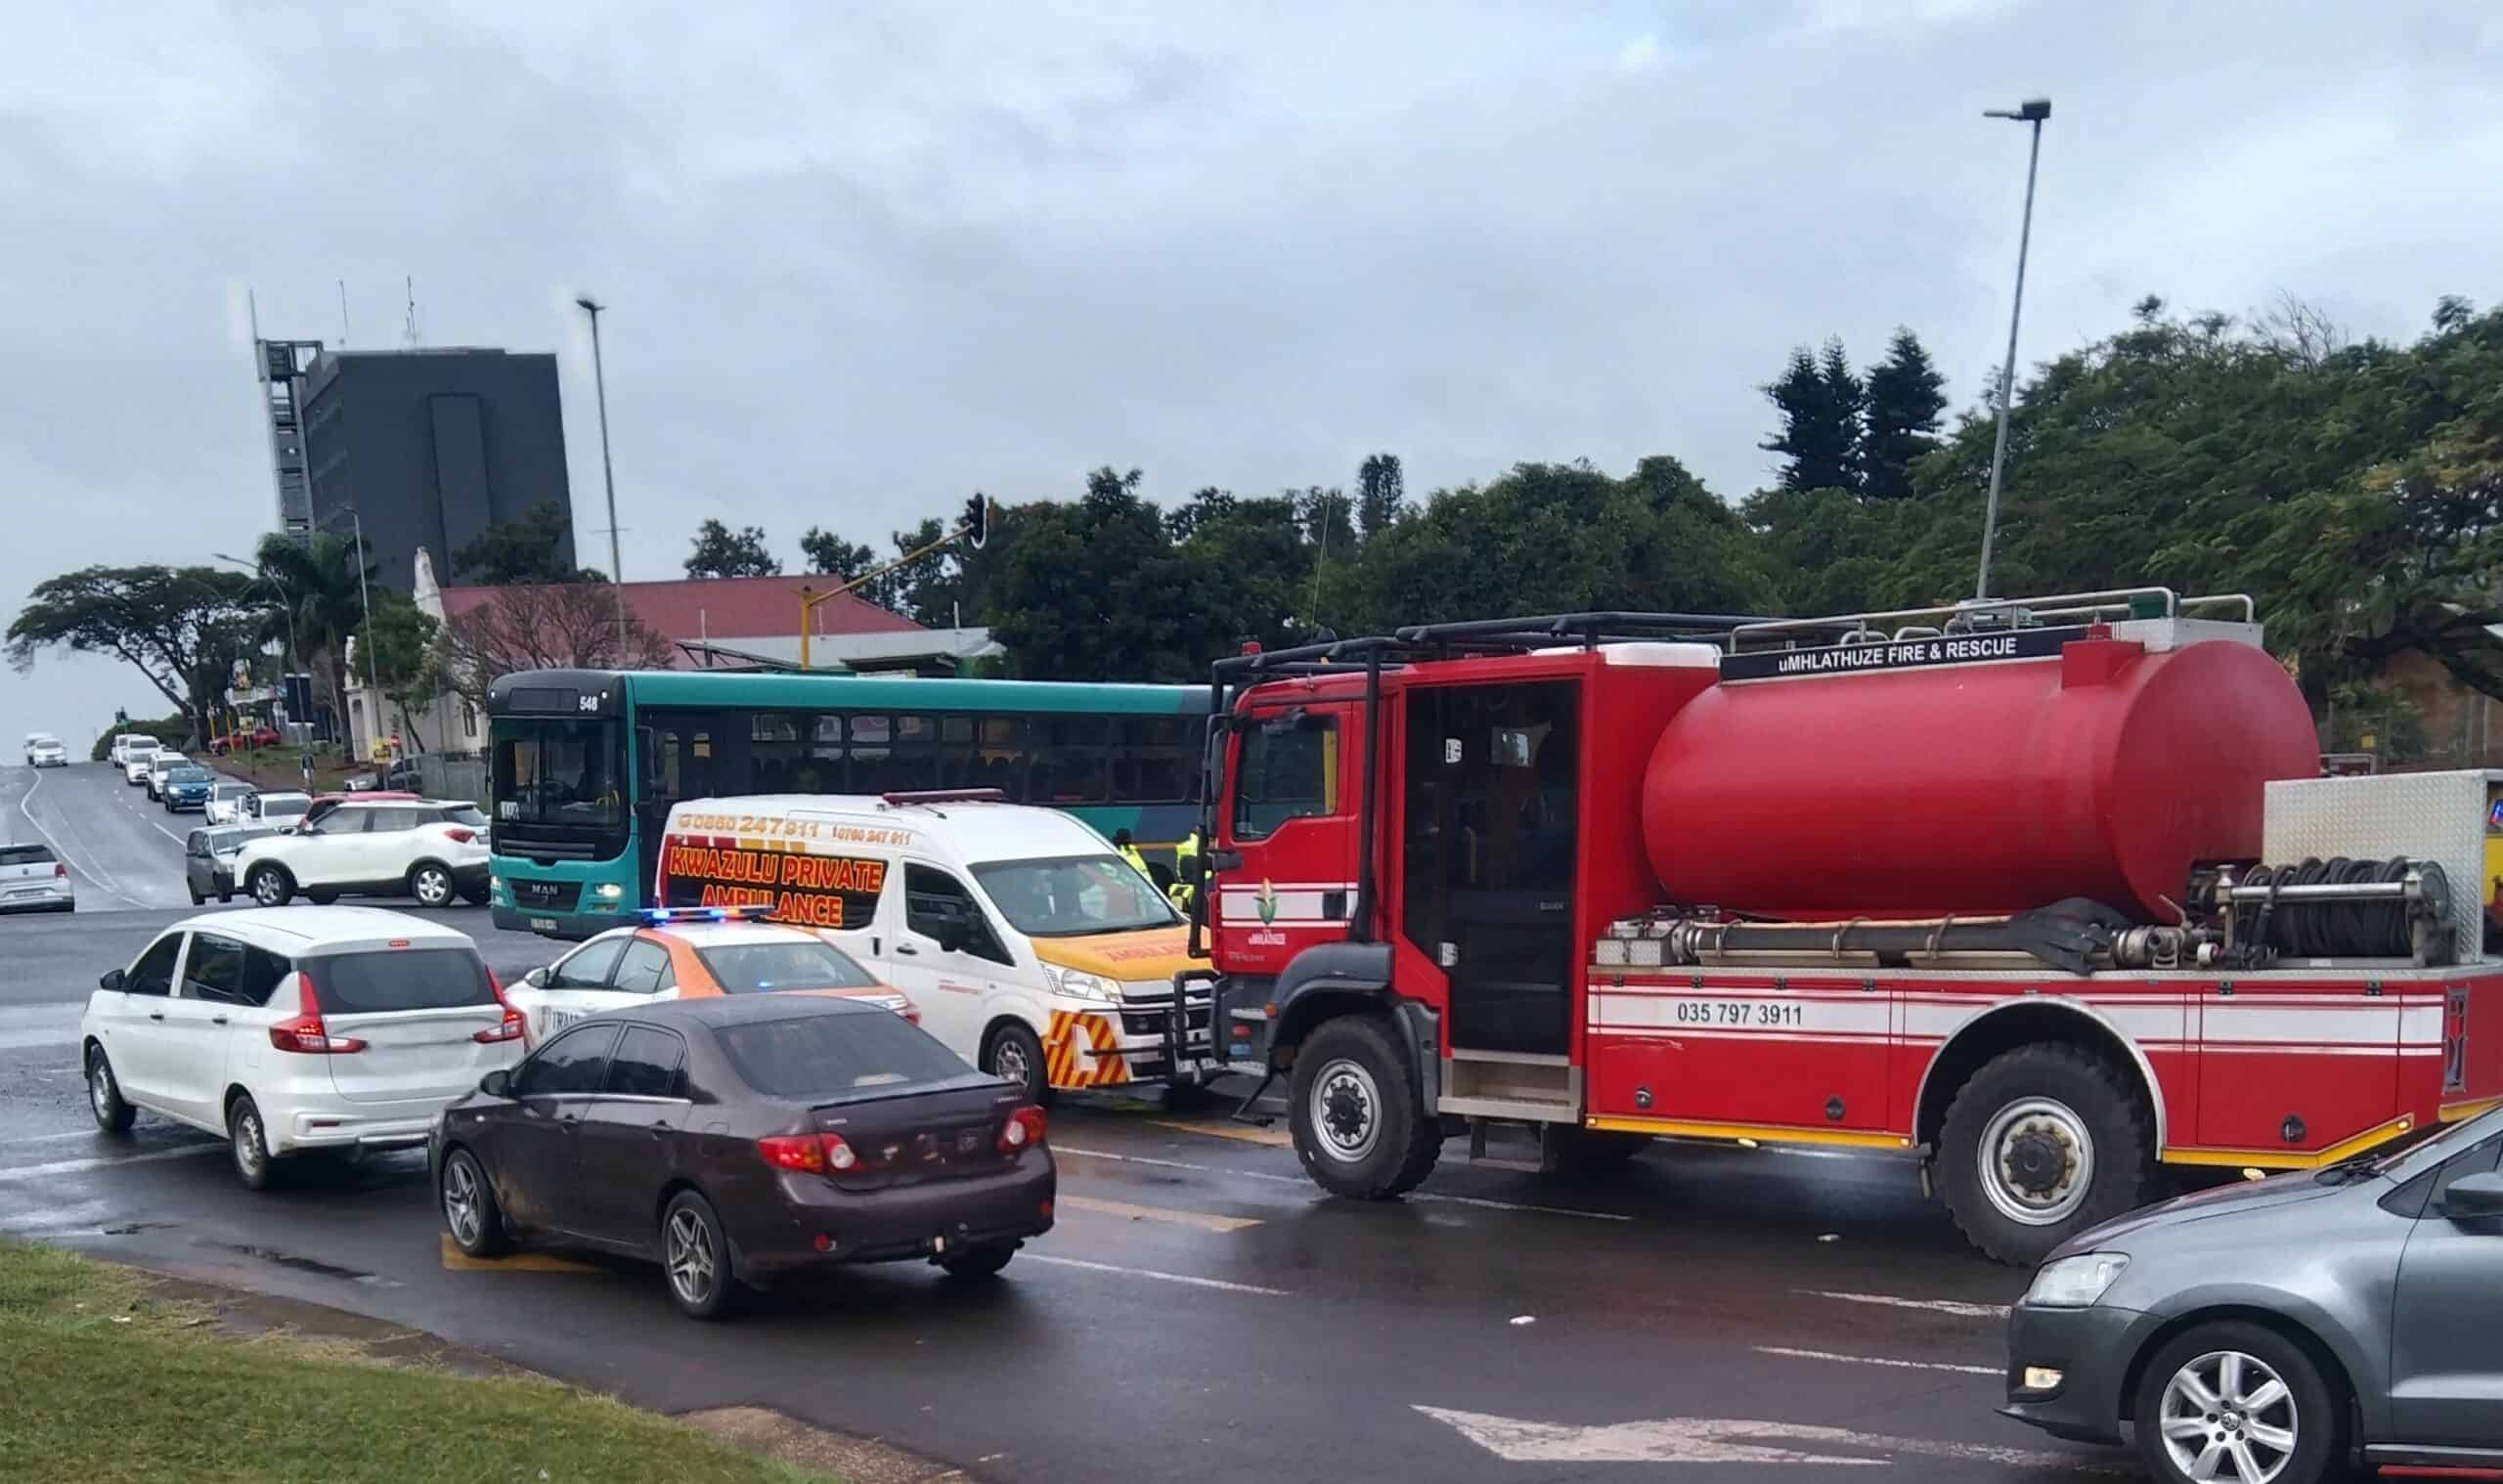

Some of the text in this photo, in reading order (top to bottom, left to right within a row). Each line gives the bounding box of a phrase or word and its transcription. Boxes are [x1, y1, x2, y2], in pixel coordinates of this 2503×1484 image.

[1778, 637, 2017, 673] uMHLATHUZE FIRE & RESCUE
[579, 695, 598, 712] 548
[738, 815, 780, 835] 247
[783, 819, 819, 838] 911
[669, 846, 884, 893] KWAZULU PRIVATE
[531, 884, 558, 895] MAN
[1677, 1002, 1802, 1026] 035 797 3911
